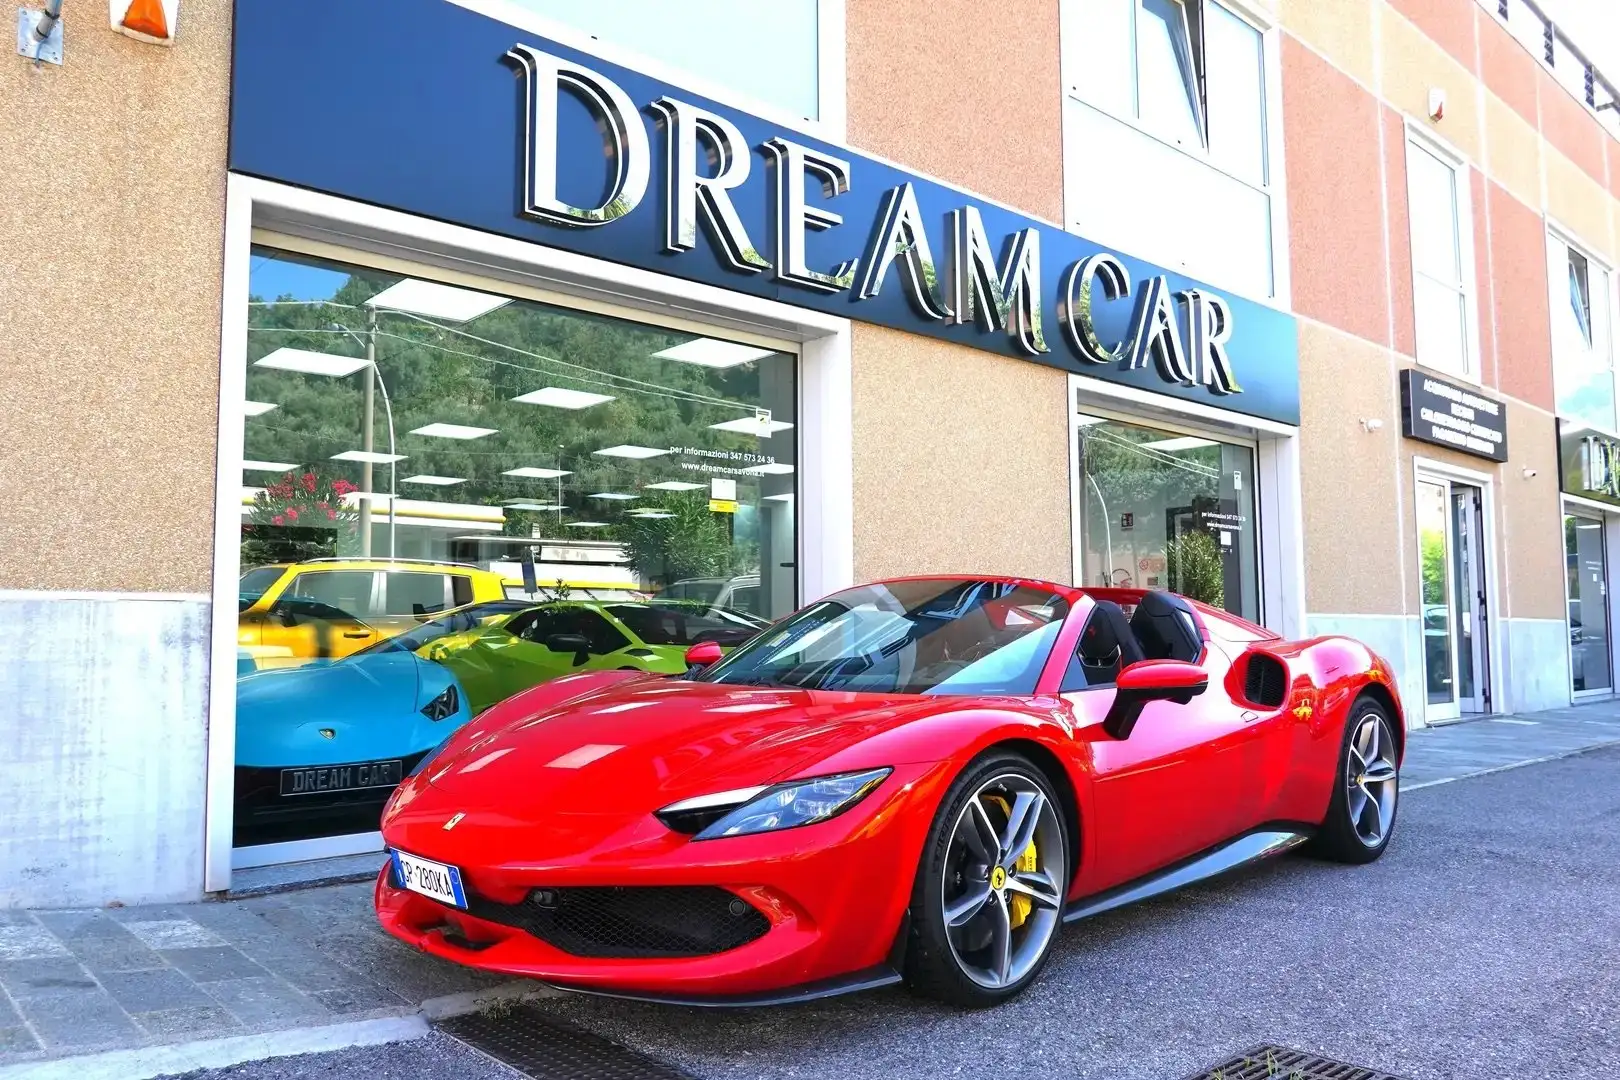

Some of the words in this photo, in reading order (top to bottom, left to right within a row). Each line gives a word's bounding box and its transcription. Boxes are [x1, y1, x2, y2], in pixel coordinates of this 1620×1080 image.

[505, 42, 1050, 356] DREAM
[1061, 253, 1244, 396] CAR
[669, 446, 683, 455] per
[684, 446, 729, 459] informazioni
[729, 451, 743, 461] 347
[744, 453, 756, 462] 573
[757, 455, 765, 463] 24
[766, 456, 775, 465] 36
[292, 767, 351, 792] DREAM
[358, 764, 391, 786] CAR
[416, 865, 454, 898] 280KA
